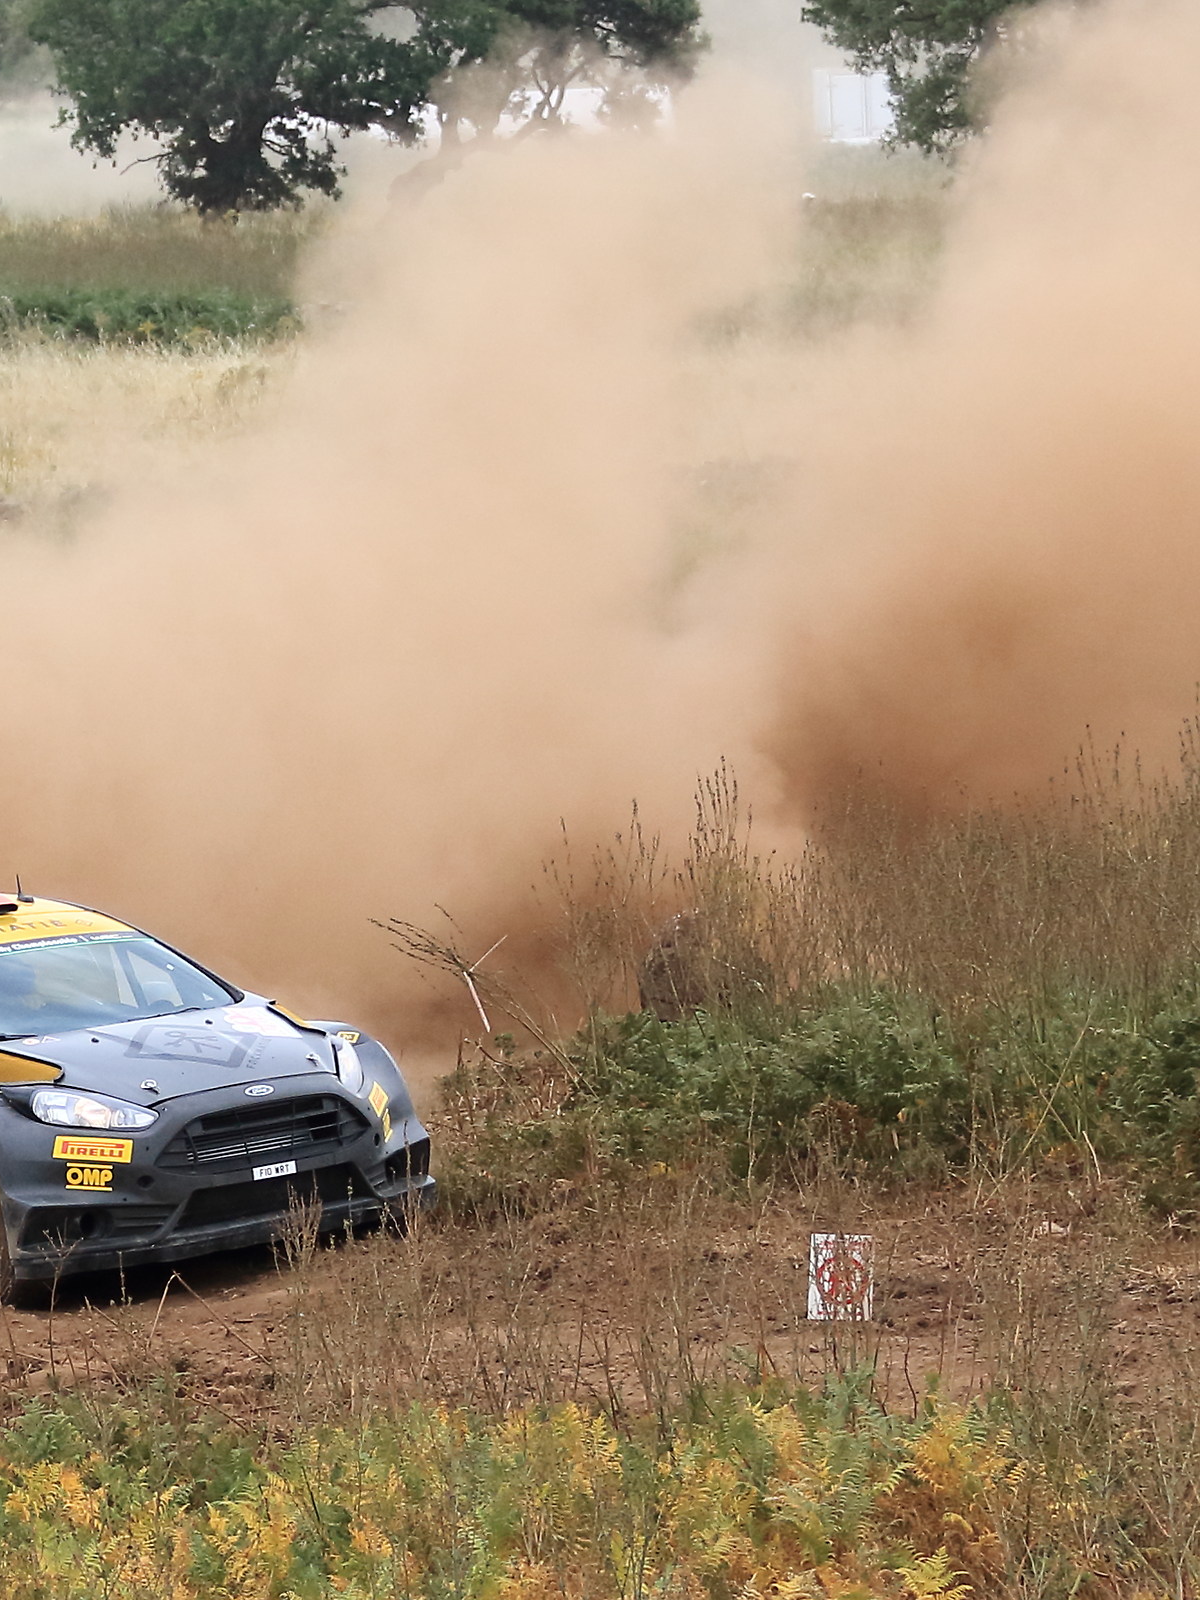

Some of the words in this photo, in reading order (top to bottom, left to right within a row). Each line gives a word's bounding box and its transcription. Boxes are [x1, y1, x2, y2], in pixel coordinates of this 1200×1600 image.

[11, 936, 78, 952] Championship
[61, 1140, 125, 1158] PIRELLI
[66, 1167, 113, 1187] OMP
[274, 1164, 290, 1175] WRT
